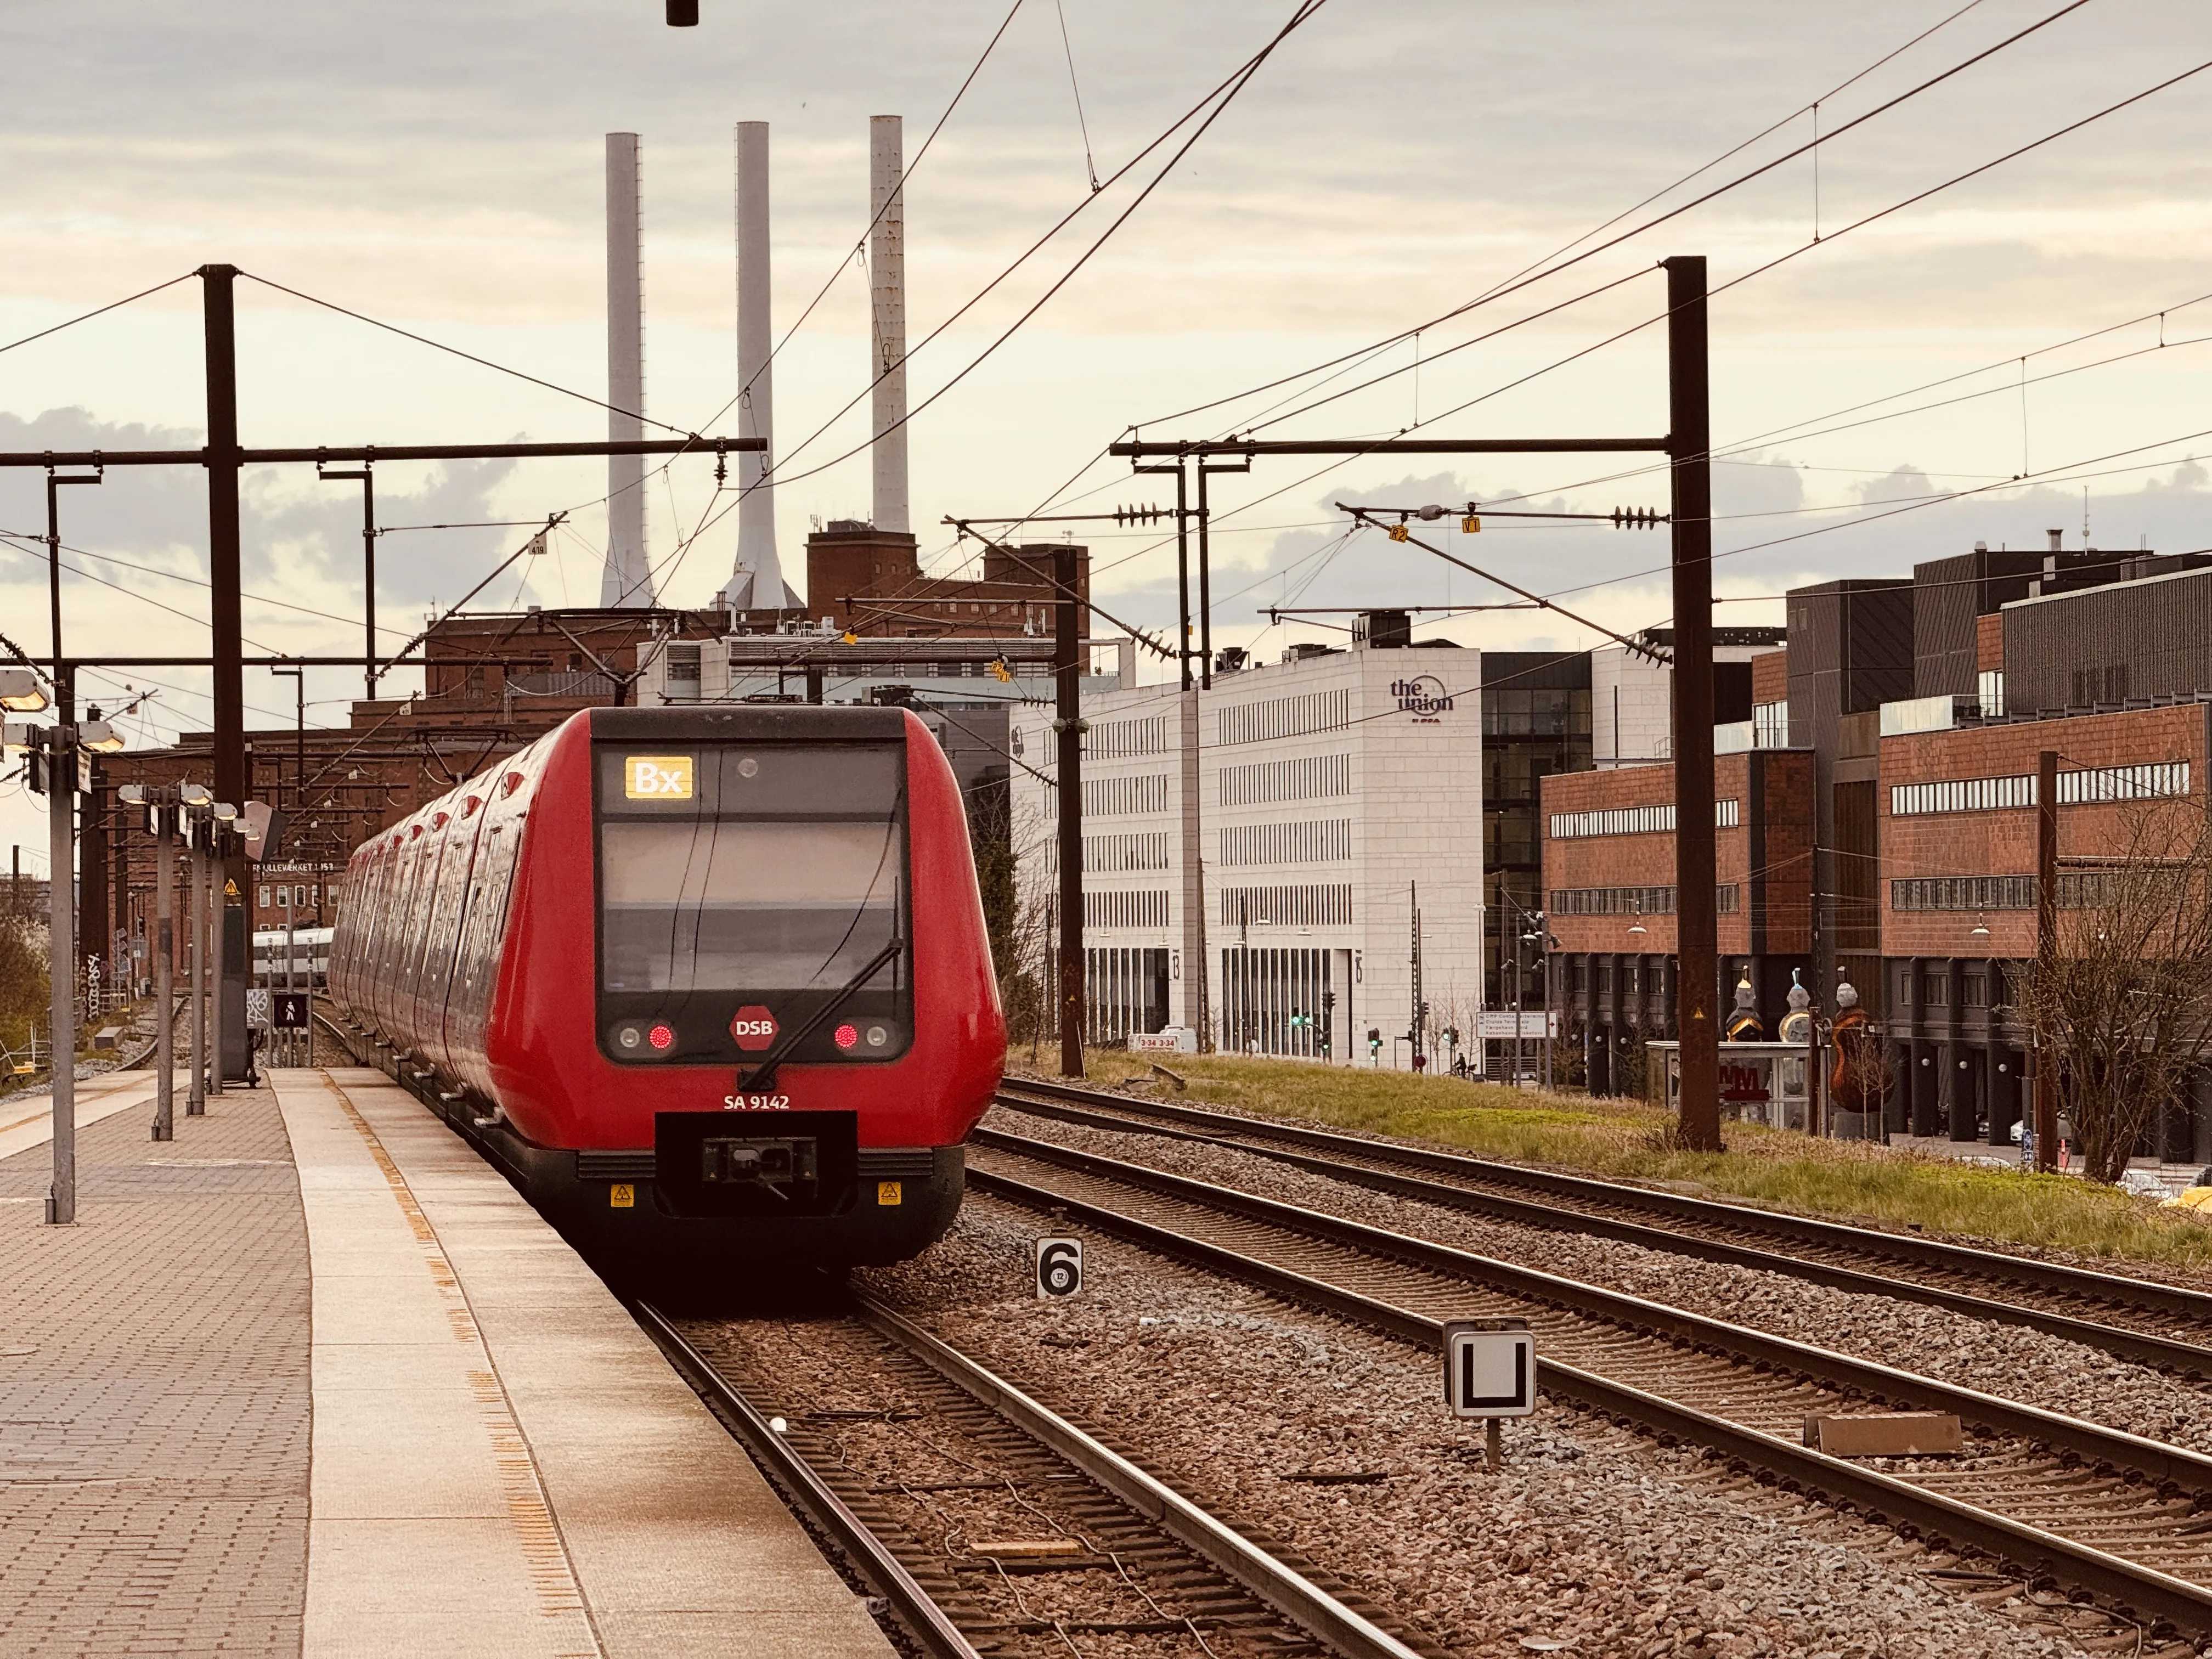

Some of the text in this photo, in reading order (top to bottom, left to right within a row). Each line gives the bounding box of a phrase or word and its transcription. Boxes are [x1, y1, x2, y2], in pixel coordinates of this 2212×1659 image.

[1391, 528, 1406, 541] R2
[1390, 679, 1421, 696] the
[1398, 693, 1453, 710] union
[636, 763, 683, 793] Bx
[736, 1021, 772, 1035] DSB
[724, 1096, 789, 1109] SA 9142
[1040, 1243, 1079, 1296] 6
